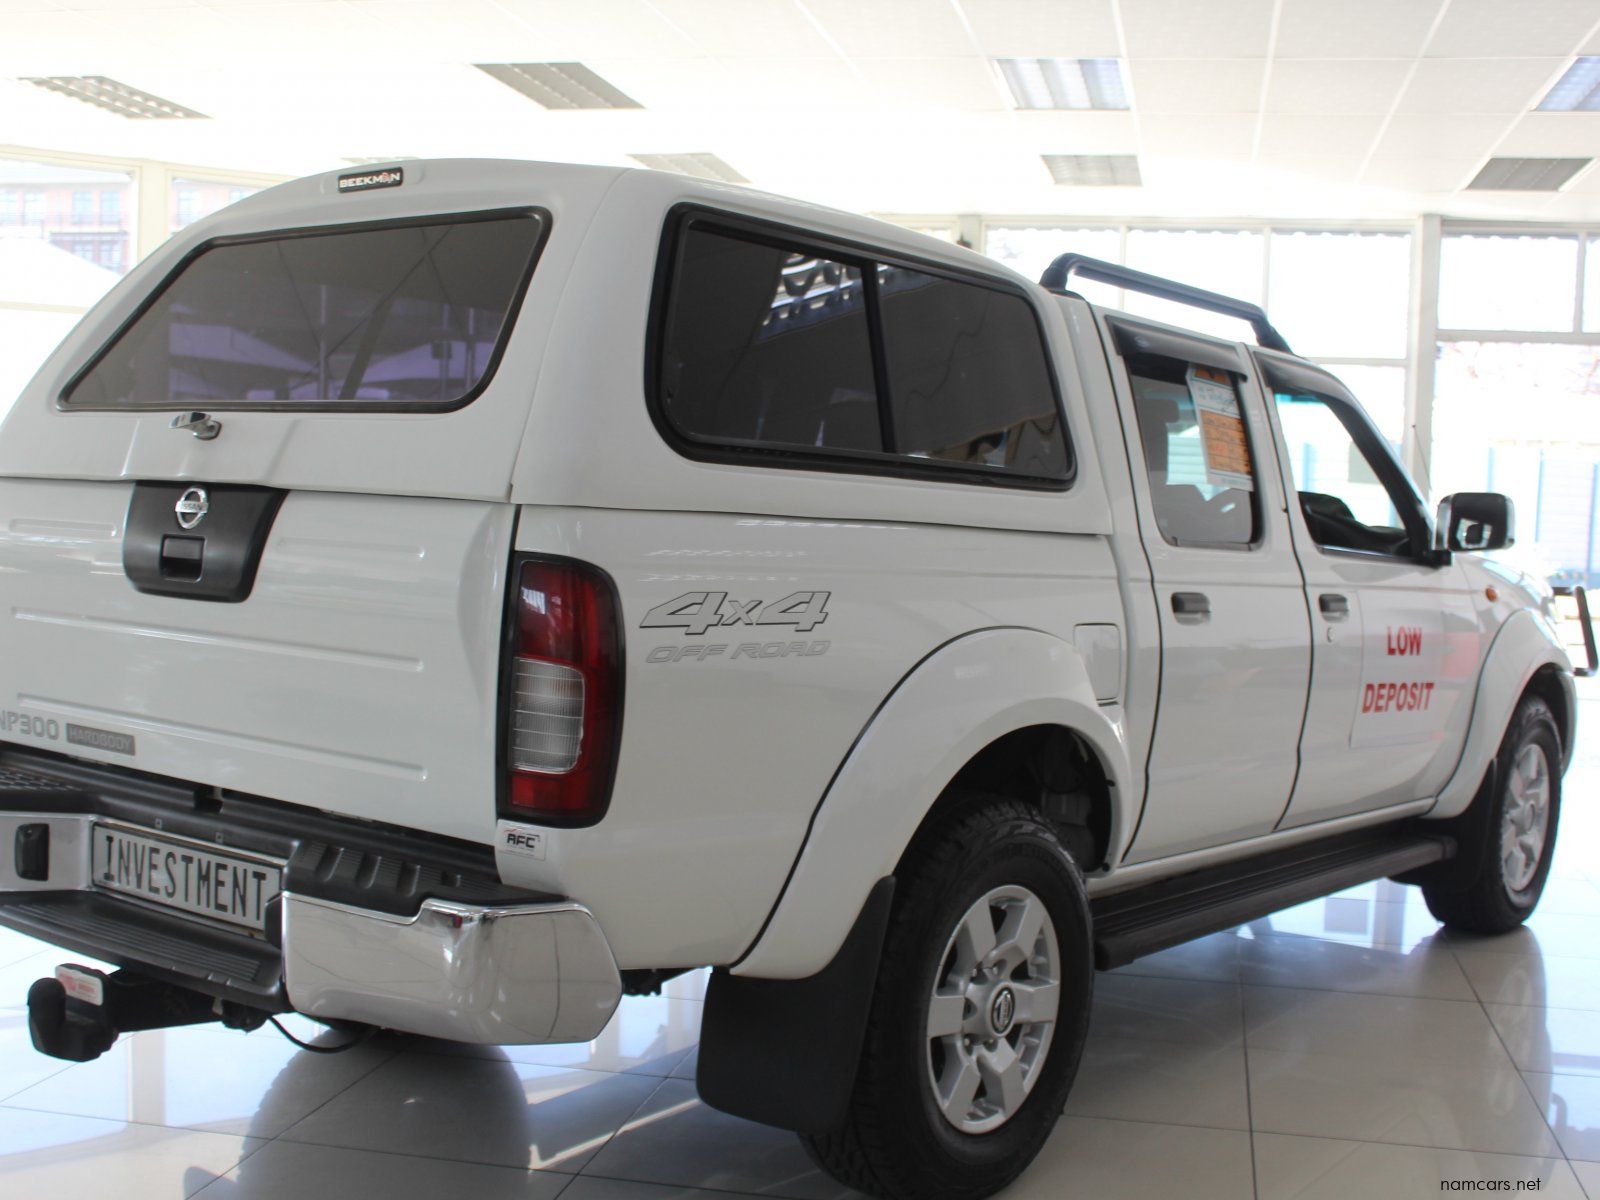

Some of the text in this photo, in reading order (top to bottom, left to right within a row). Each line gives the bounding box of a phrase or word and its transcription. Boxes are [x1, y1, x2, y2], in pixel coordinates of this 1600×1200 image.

[339, 172, 401, 188] BEEKMAN
[639, 591, 831, 635] 4x4
[646, 640, 831, 663] OFF ROAD
[1387, 626, 1422, 656] LOW
[1362, 682, 1434, 713] DEPOSIT
[103, 835, 267, 921] INVESTMENT
